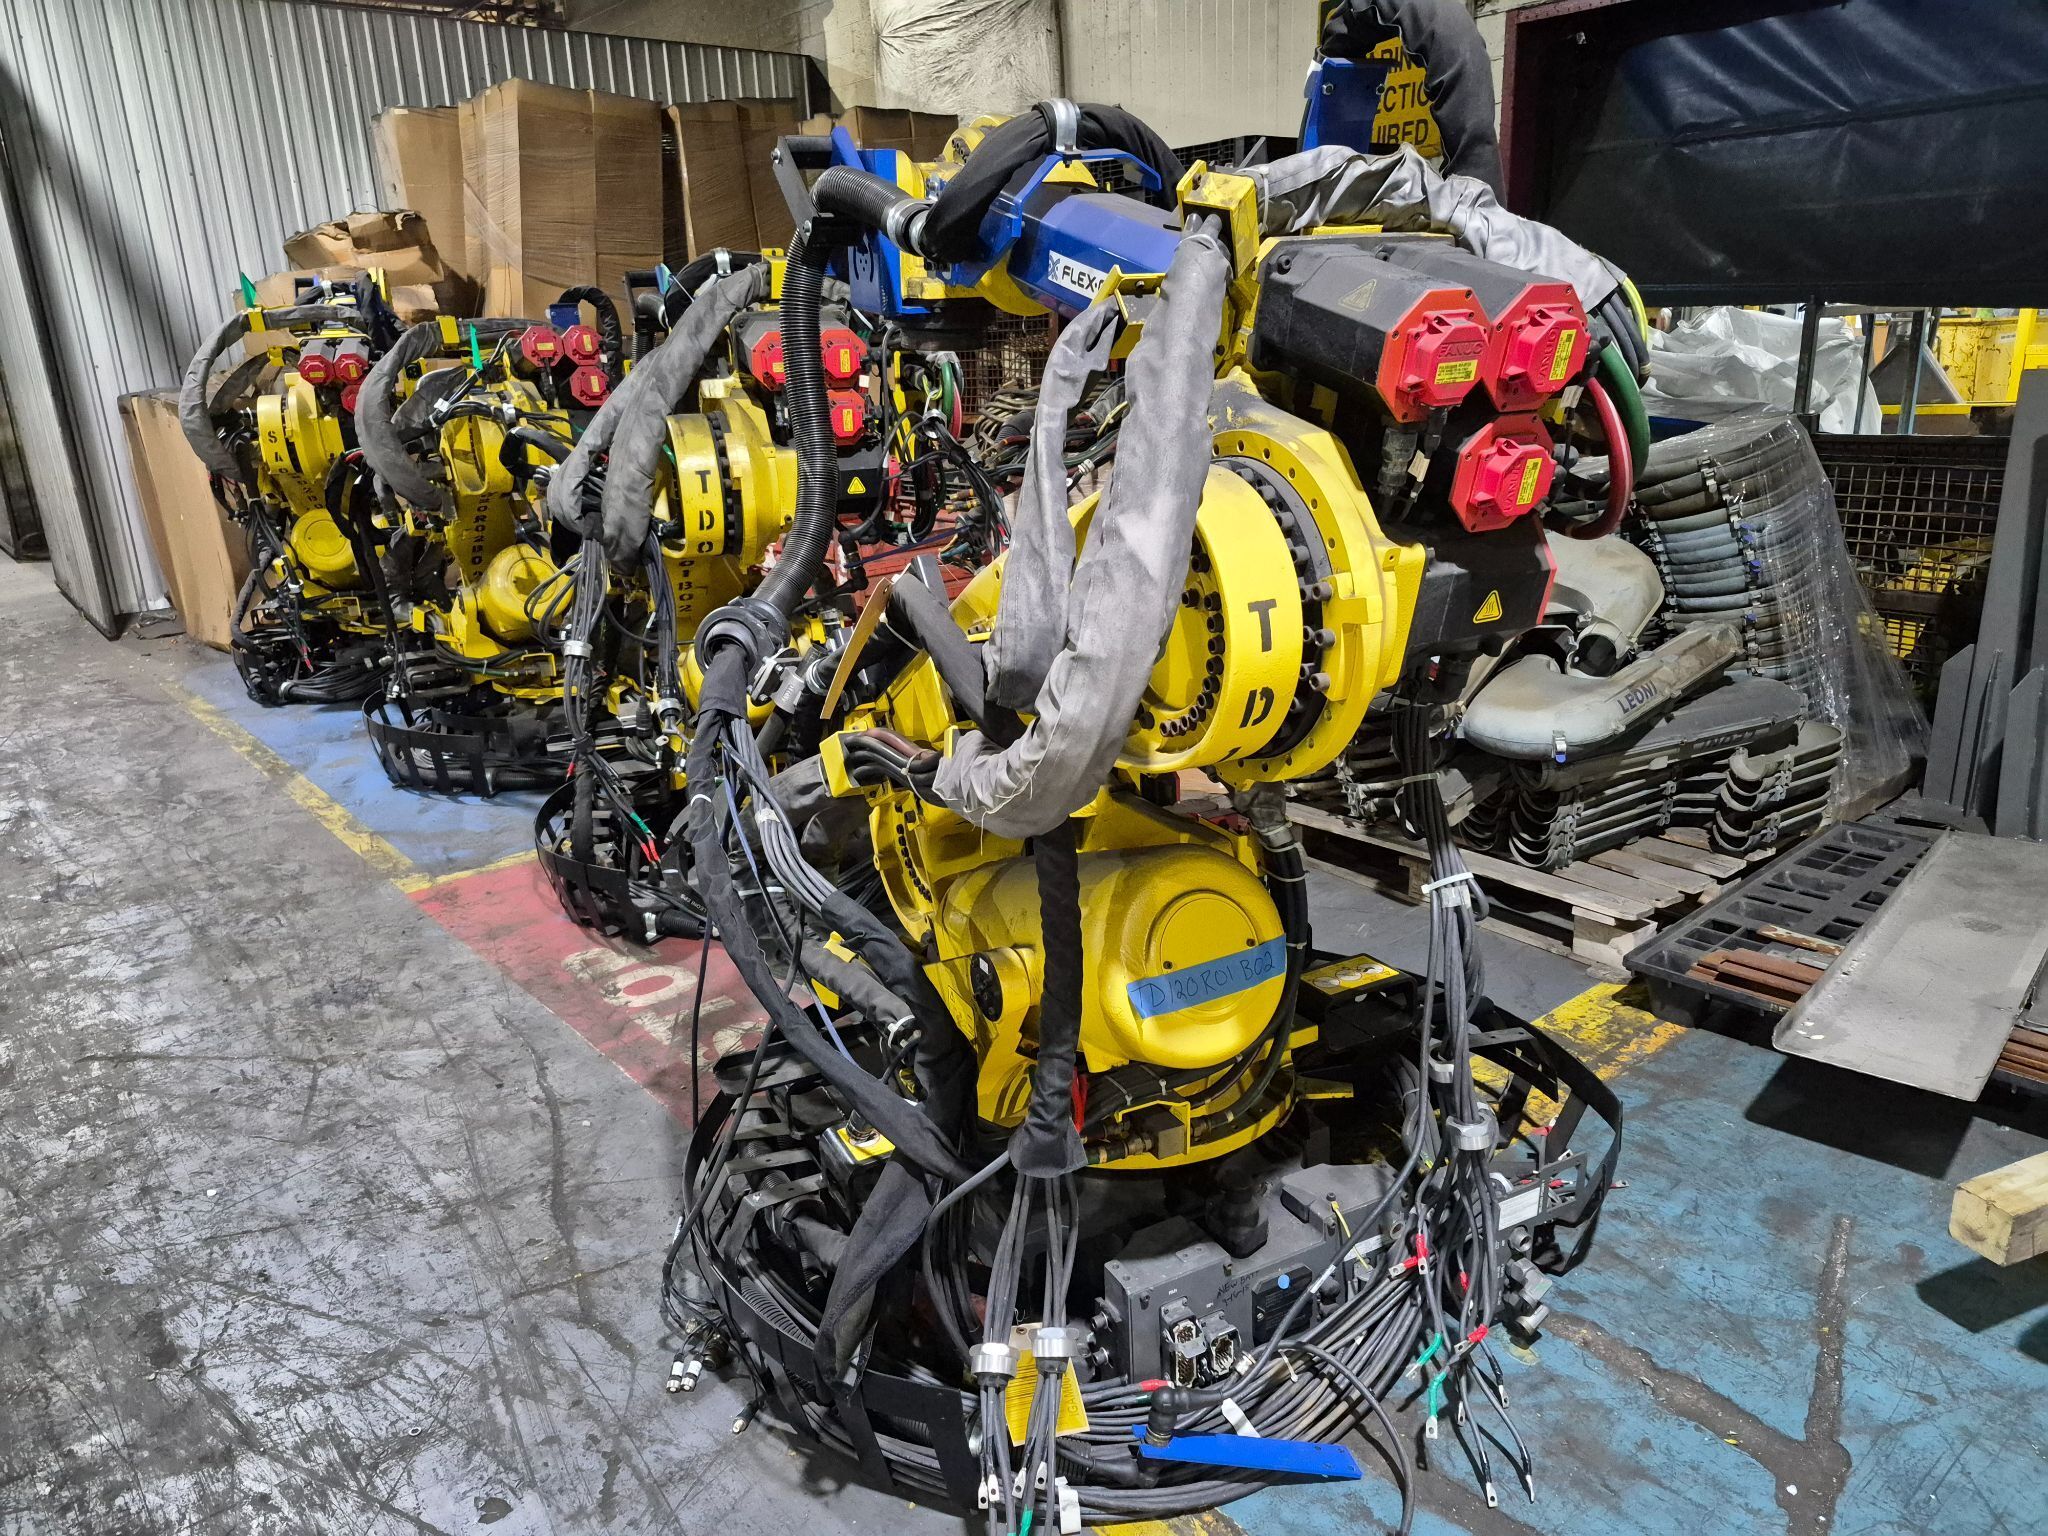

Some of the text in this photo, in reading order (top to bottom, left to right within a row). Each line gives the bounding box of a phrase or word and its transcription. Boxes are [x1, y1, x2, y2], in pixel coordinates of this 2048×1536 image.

[1375, 80, 1429, 114] CTIO
[1438, 342, 1484, 358] FANUC
[1617, 680, 1658, 714] LEONI
